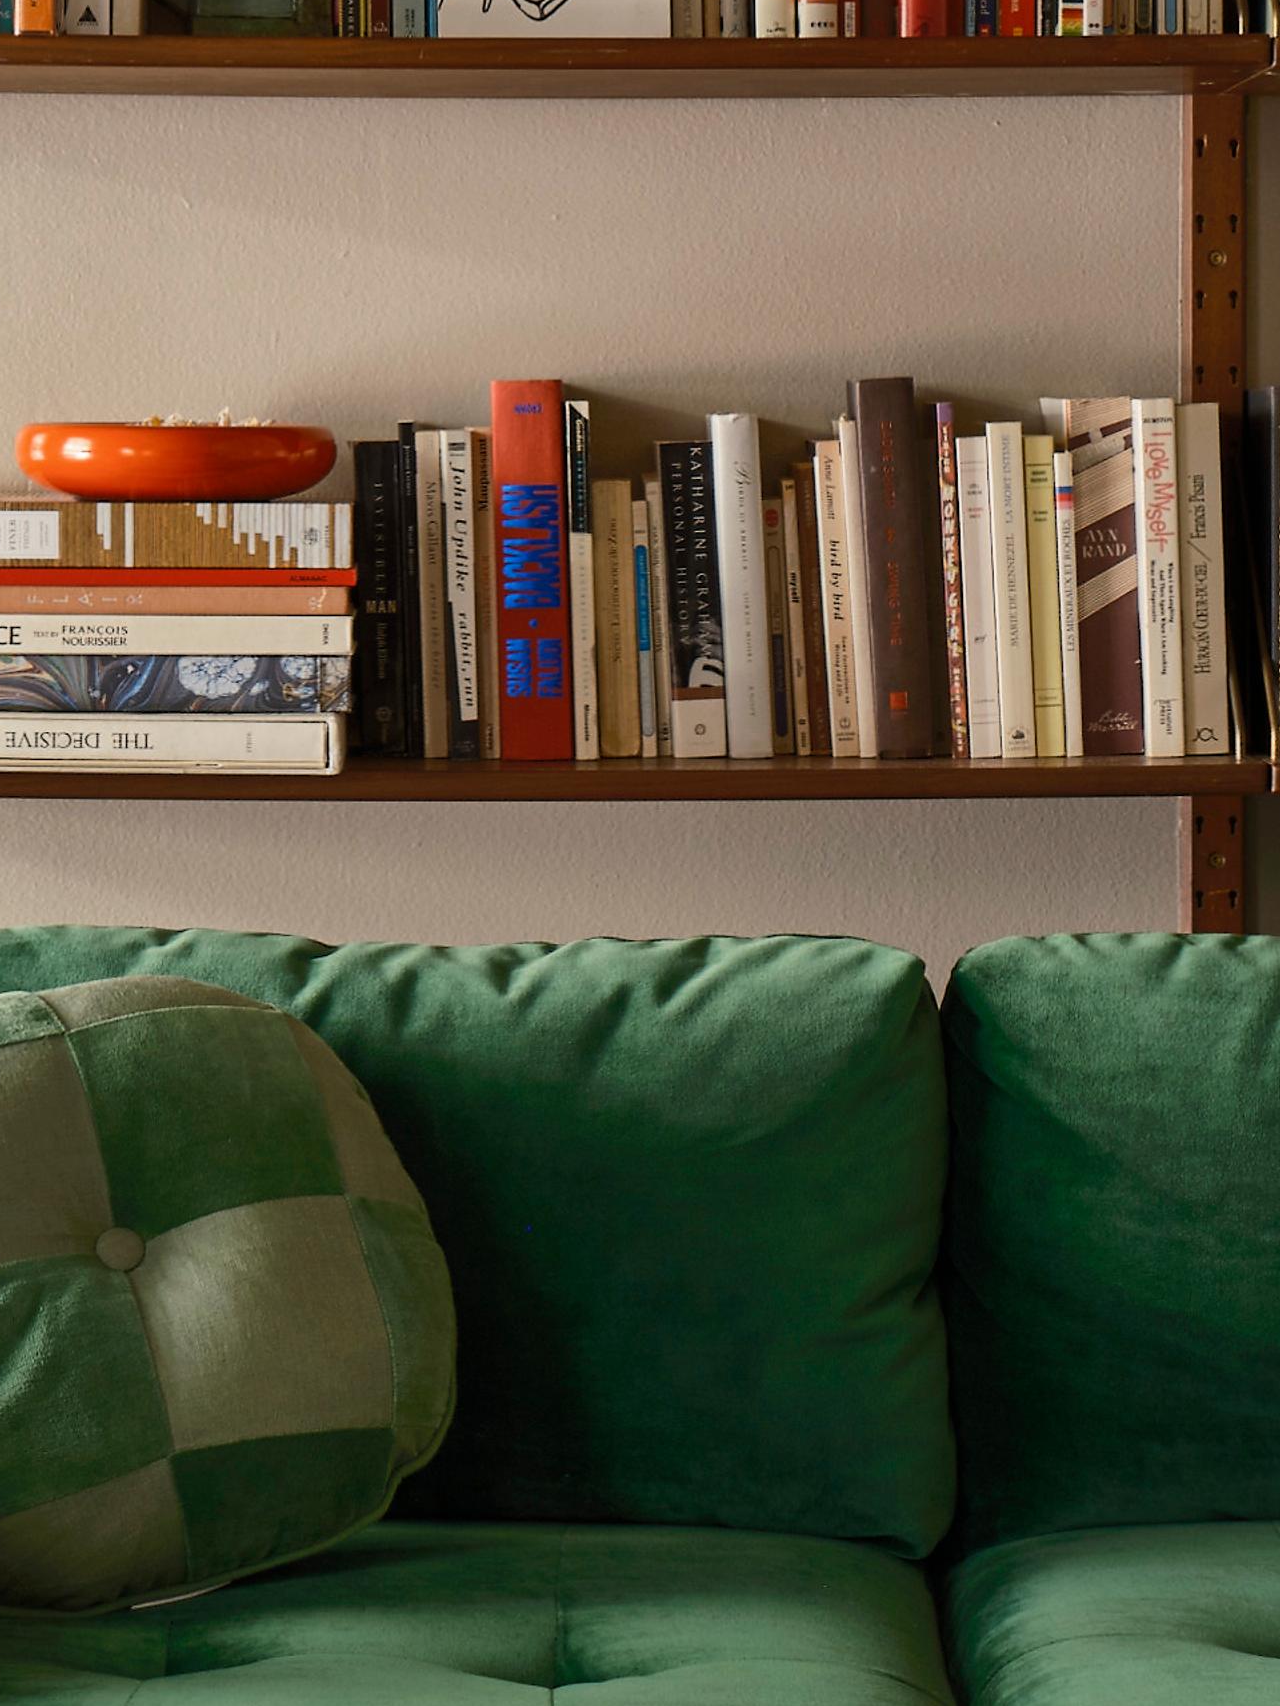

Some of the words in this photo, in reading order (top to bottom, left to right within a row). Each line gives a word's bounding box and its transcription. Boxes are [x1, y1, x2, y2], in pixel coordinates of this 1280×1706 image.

[425, 481, 436, 517] Mavis
[450, 461, 467, 511] John
[689, 446, 709, 561] KATHARINE
[1187, 474, 1206, 503] Pisani
[671, 462, 687, 554] PERSONAL
[1188, 505, 1206, 539] Francis
[426, 520, 439, 566] Gallant
[453, 518, 468, 592] Updike
[501, 483, 561, 609] BACKLASH
[829, 539, 842, 567] bird
[1082, 543, 1127, 558] RAND
[830, 572, 842, 588] by
[366, 600, 398, 614] MAN
[675, 567, 691, 646] HISTORY
[695, 572, 713, 657] GRAHAM
[833, 592, 844, 621] bird
[62, 636, 128, 646] NOURISSIER
[458, 611, 473, 671] rabbit,
[506, 638, 532, 698] SUSAN
[537, 638, 562, 698] FALUDI
[464, 676, 475, 707] run
[5, 732, 101, 749] DECISIVE
[113, 733, 154, 749] THE
